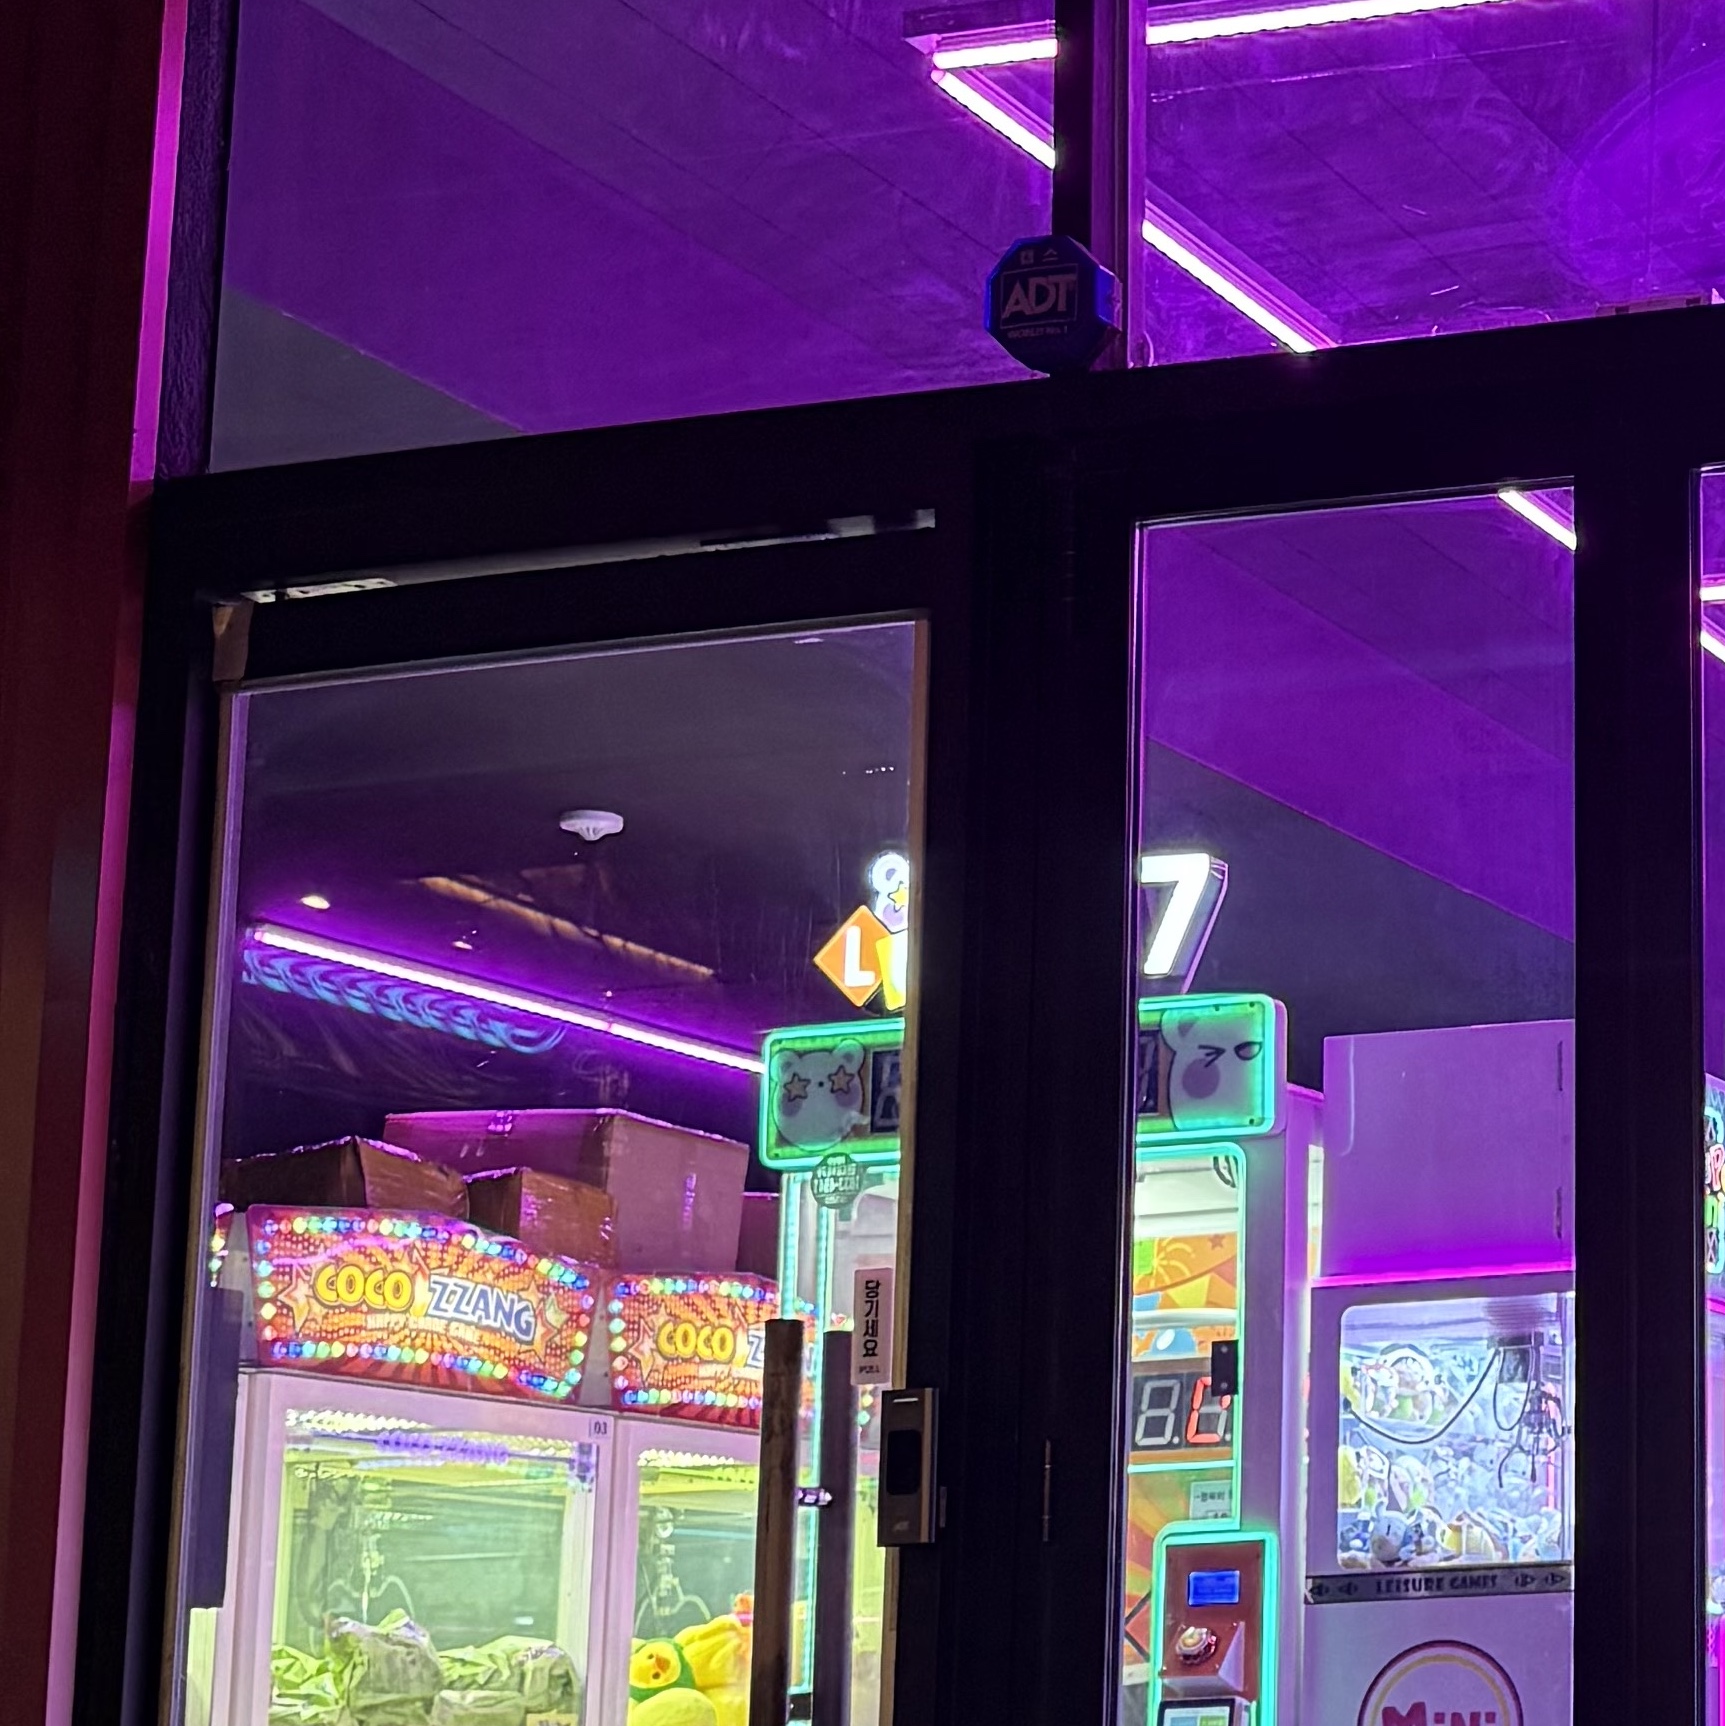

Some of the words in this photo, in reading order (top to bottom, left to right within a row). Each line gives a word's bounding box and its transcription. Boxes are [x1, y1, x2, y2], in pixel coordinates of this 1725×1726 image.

[1002, 274, 1077, 319] ADT
[1141, 852, 1211, 976] 7
[313, 1264, 412, 1312] COCO
[427, 1274, 537, 1342] ZZANG
[862, 1279, 882, 1358] 당기세요
[657, 1321, 735, 1362] COCO
[1375, 1577, 1444, 1594] LEISURE
[1450, 1573, 1498, 1591] GAMES
